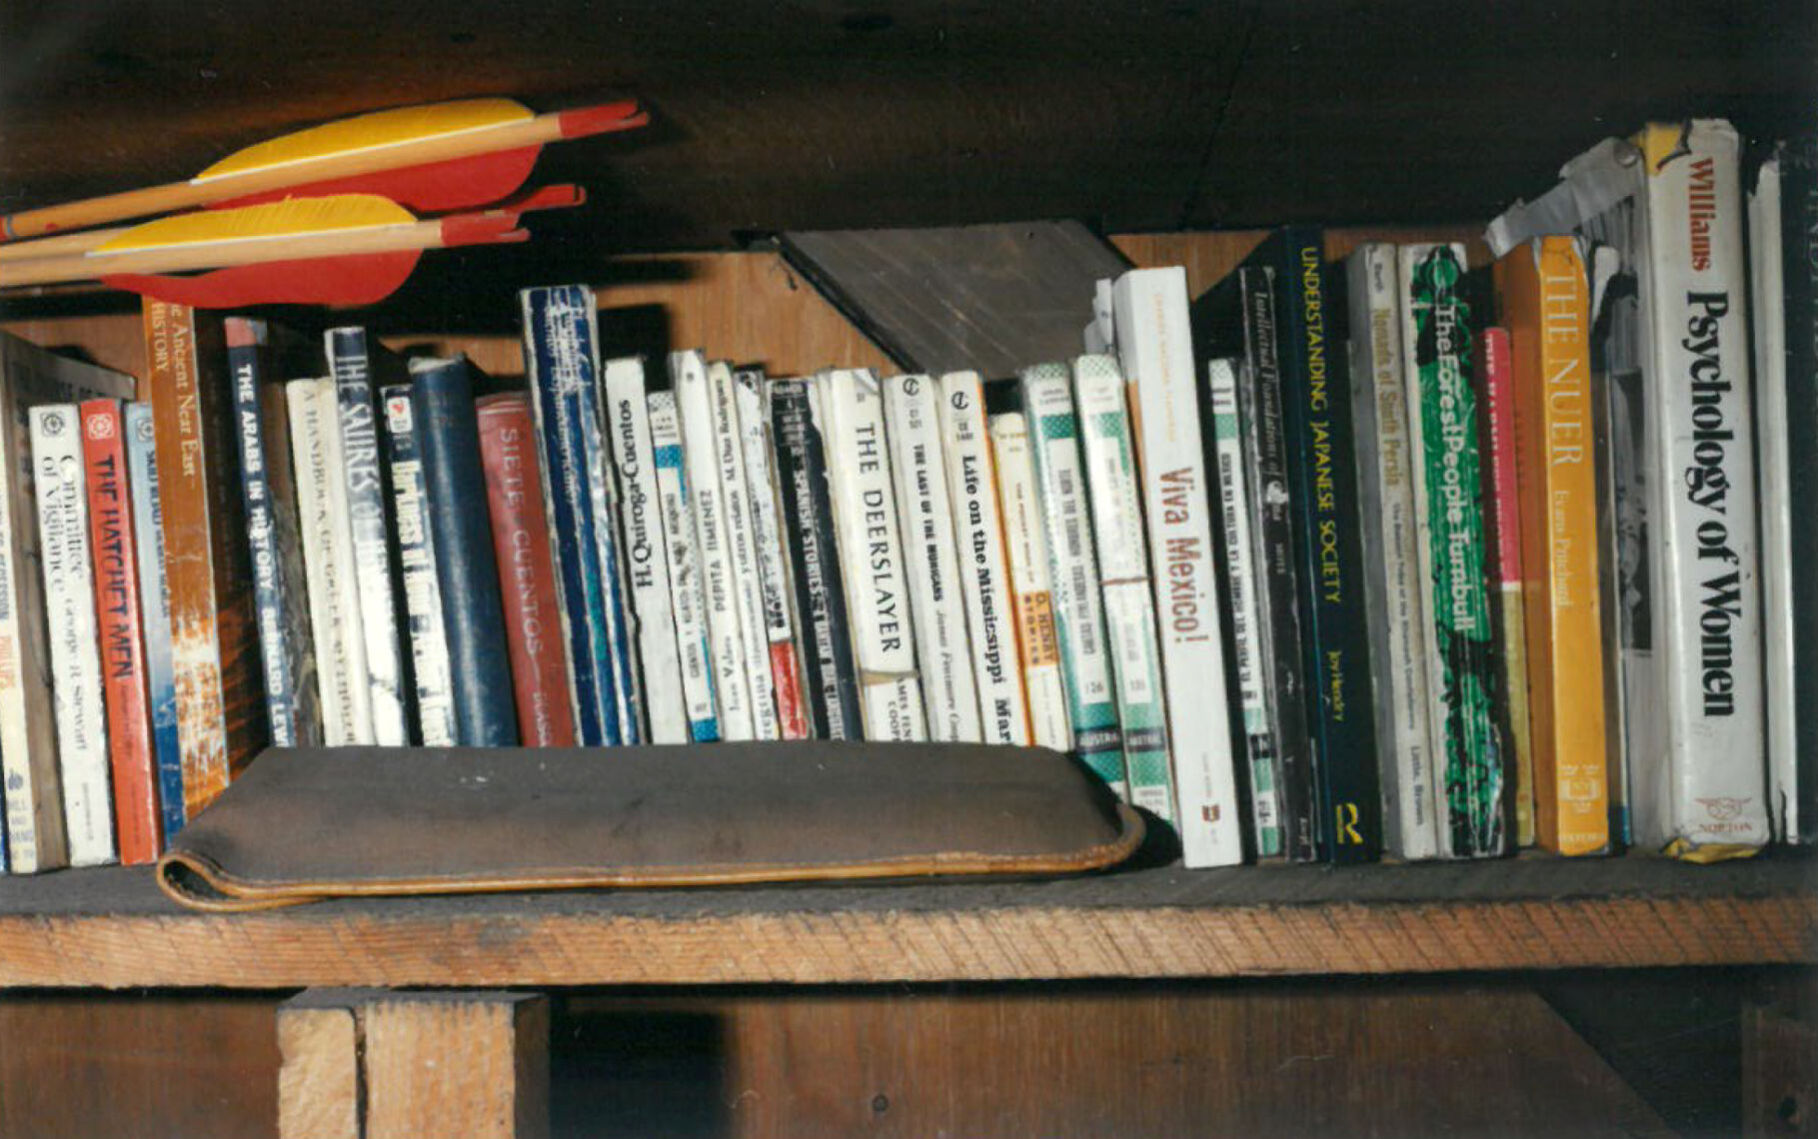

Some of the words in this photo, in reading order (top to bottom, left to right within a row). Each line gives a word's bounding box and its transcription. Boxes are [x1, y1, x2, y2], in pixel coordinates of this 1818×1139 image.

[1688, 156, 1717, 272] Williams
[1300, 246, 1329, 412] UNDERSTANDING
[1546, 270, 1580, 344] THE
[172, 323, 190, 388] Ancient
[1372, 308, 1392, 366] Nomads
[237, 363, 254, 402] THE
[1376, 370, 1394, 387] of
[1681, 290, 1736, 514] Psychology
[178, 394, 197, 435] Near
[1548, 358, 1585, 467] NUER
[42, 455, 59, 479] of
[182, 440, 199, 478] East
[240, 411, 263, 473] ARABS
[498, 428, 525, 507] SIETE
[855, 422, 880, 474] THE
[912, 444, 925, 466] THE
[1309, 419, 1336, 513] JAPANESE
[1383, 439, 1404, 487] Persia
[93, 454, 118, 502] THE
[248, 481, 264, 501] IN
[916, 470, 930, 496] LAST
[961, 455, 980, 494] Life
[1159, 467, 1195, 525] Viva
[919, 500, 933, 514] OF
[923, 519, 937, 540] THE
[967, 499, 983, 526] on
[42, 487, 67, 592] Vigilance
[97, 509, 129, 617] HATCHET
[249, 507, 275, 590] HISTORY
[972, 529, 990, 564] the
[1319, 519, 1343, 602] SOCIETY
[1697, 520, 1740, 566] of
[511, 529, 543, 657] CUENTOS
[634, 565, 654, 588] H.
[862, 489, 902, 654] DEERSLAYER
[1165, 537, 1209, 643] Mexico!
[1448, 526, 1477, 632] Turnbull
[110, 624, 135, 679] MEN
[976, 567, 1008, 685] Mississippi
[1037, 613, 1055, 662] HENRY
[1699, 569, 1743, 718] Women
[894, 679, 910, 710] AMES
[994, 698, 1014, 743] Mar
